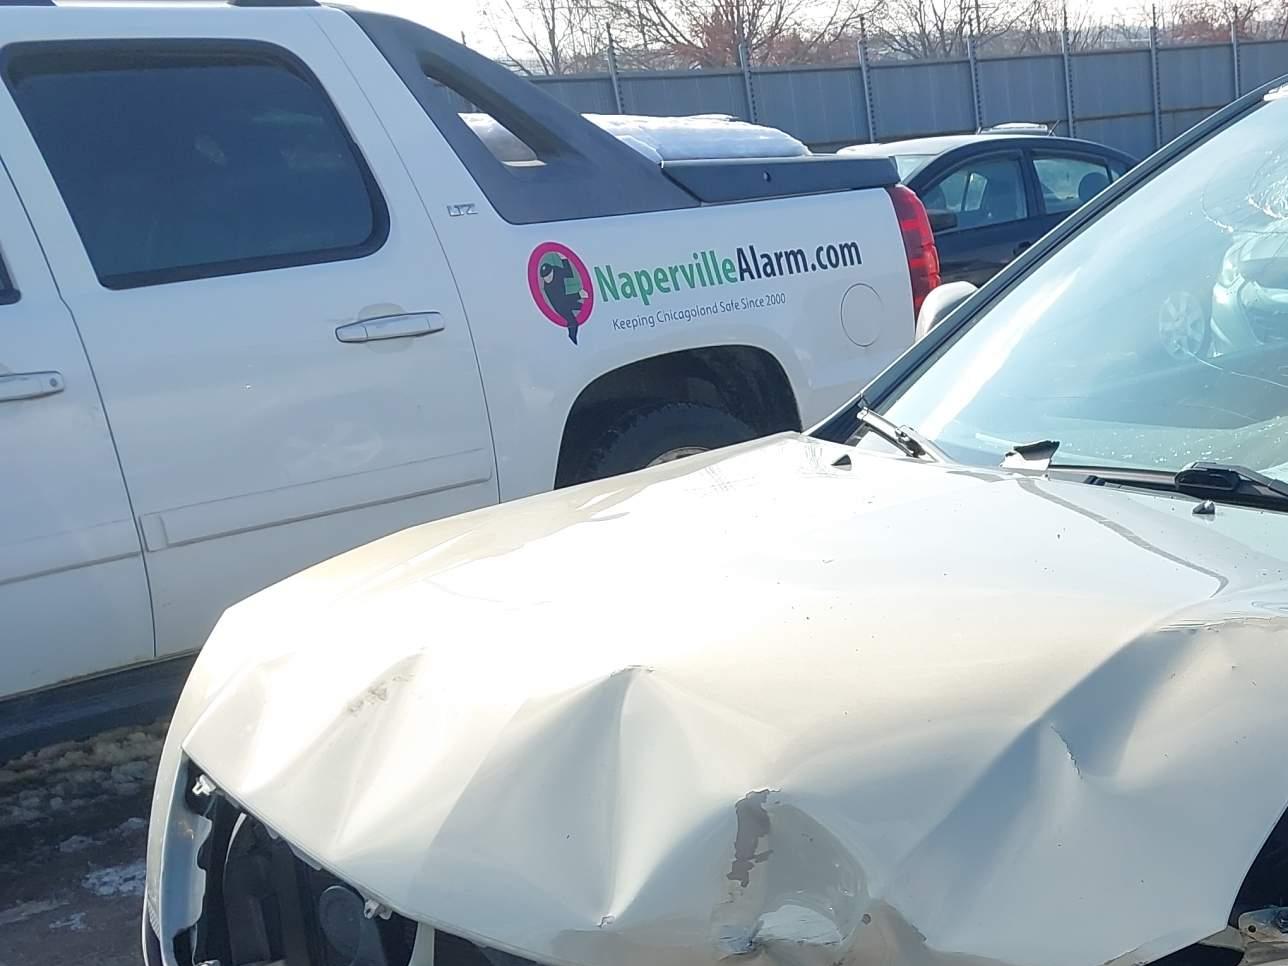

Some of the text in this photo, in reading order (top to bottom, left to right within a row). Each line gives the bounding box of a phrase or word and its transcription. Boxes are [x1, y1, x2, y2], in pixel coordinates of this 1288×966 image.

[593, 241, 863, 306] NapervilleAlarm.com
[612, 315, 655, 331] Keeping
[741, 297, 765, 310] Since
[766, 293, 786, 306] 2000
